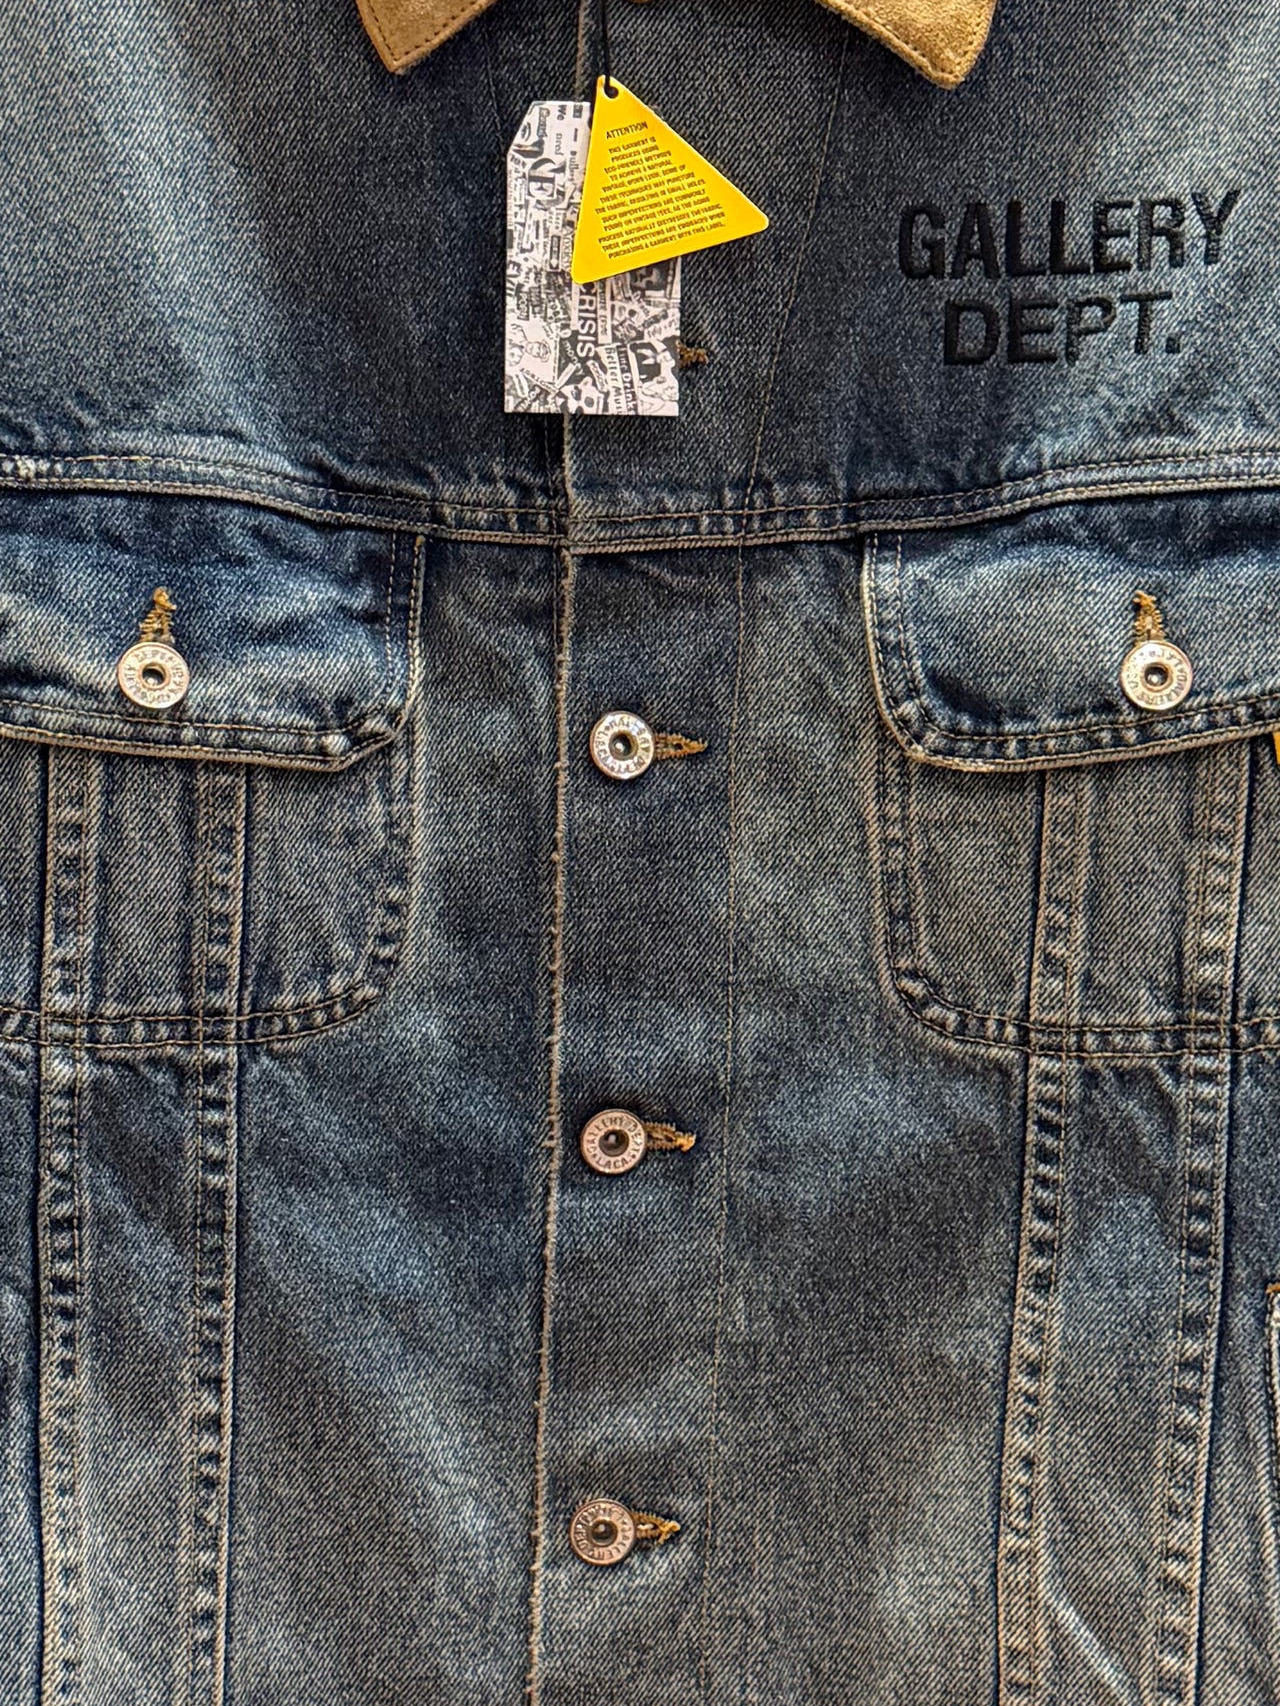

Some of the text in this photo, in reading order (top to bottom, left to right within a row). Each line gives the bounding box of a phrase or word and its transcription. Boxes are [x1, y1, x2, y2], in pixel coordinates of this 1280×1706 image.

[606, 121, 648, 139] ATTENTION
[899, 190, 1241, 279] GALLERY
[576, 283, 596, 357] CRISIS
[943, 291, 1181, 366] DEPT.
